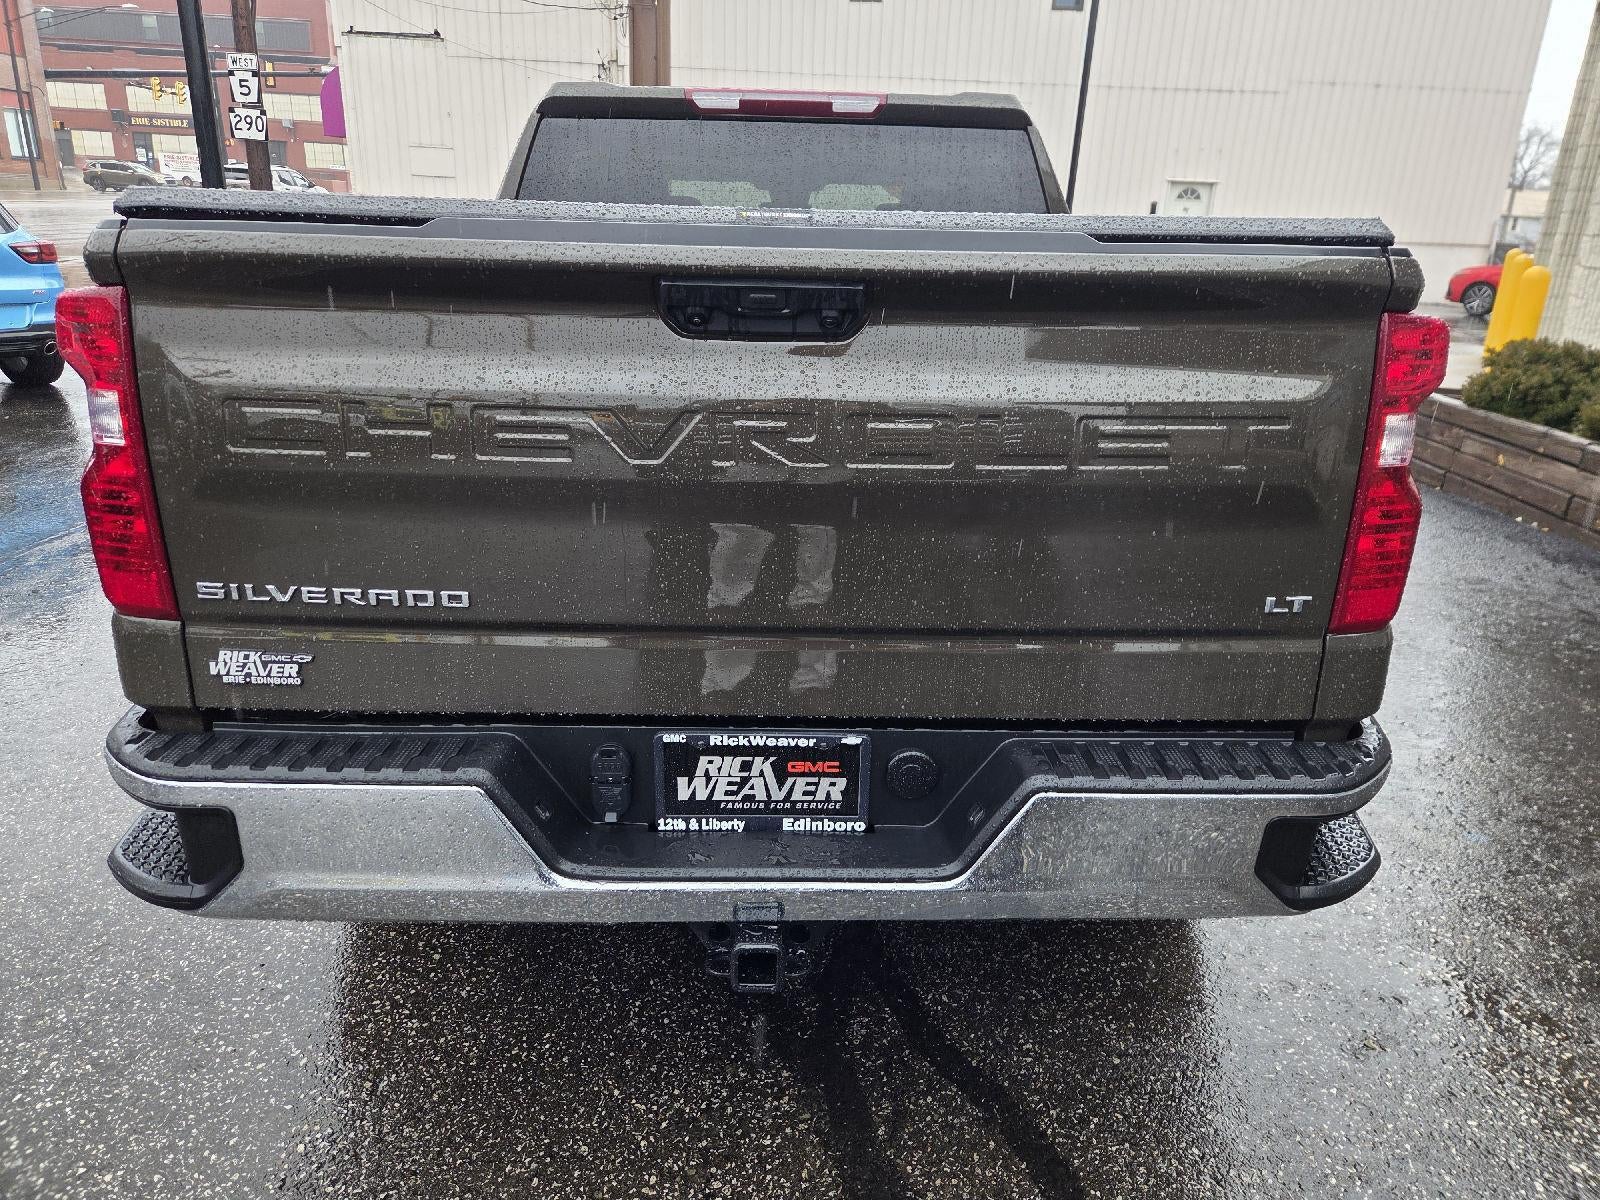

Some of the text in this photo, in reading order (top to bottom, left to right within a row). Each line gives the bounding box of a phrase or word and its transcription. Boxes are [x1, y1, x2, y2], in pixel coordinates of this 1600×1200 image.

[230, 55, 254, 68] WEST
[238, 78, 252, 97] 5
[233, 113, 265, 133] 290
[223, 400, 1292, 471] CHEVROLET
[196, 581, 470, 609] SILVERADO
[1264, 594, 1312, 614] LT
[218, 650, 263, 663] RICK
[261, 654, 291, 662] GMC
[208, 661, 299, 677] WEAVER
[222, 675, 301, 685] ERIE EDINBORO
[662, 734, 687, 743] GMC
[694, 755, 778, 777] RICK
[787, 761, 842, 773] GMC
[676, 776, 848, 801] WEAVER
[657, 818, 746, 833] 12th & Liberty
[782, 817, 867, 832] Edinboro
